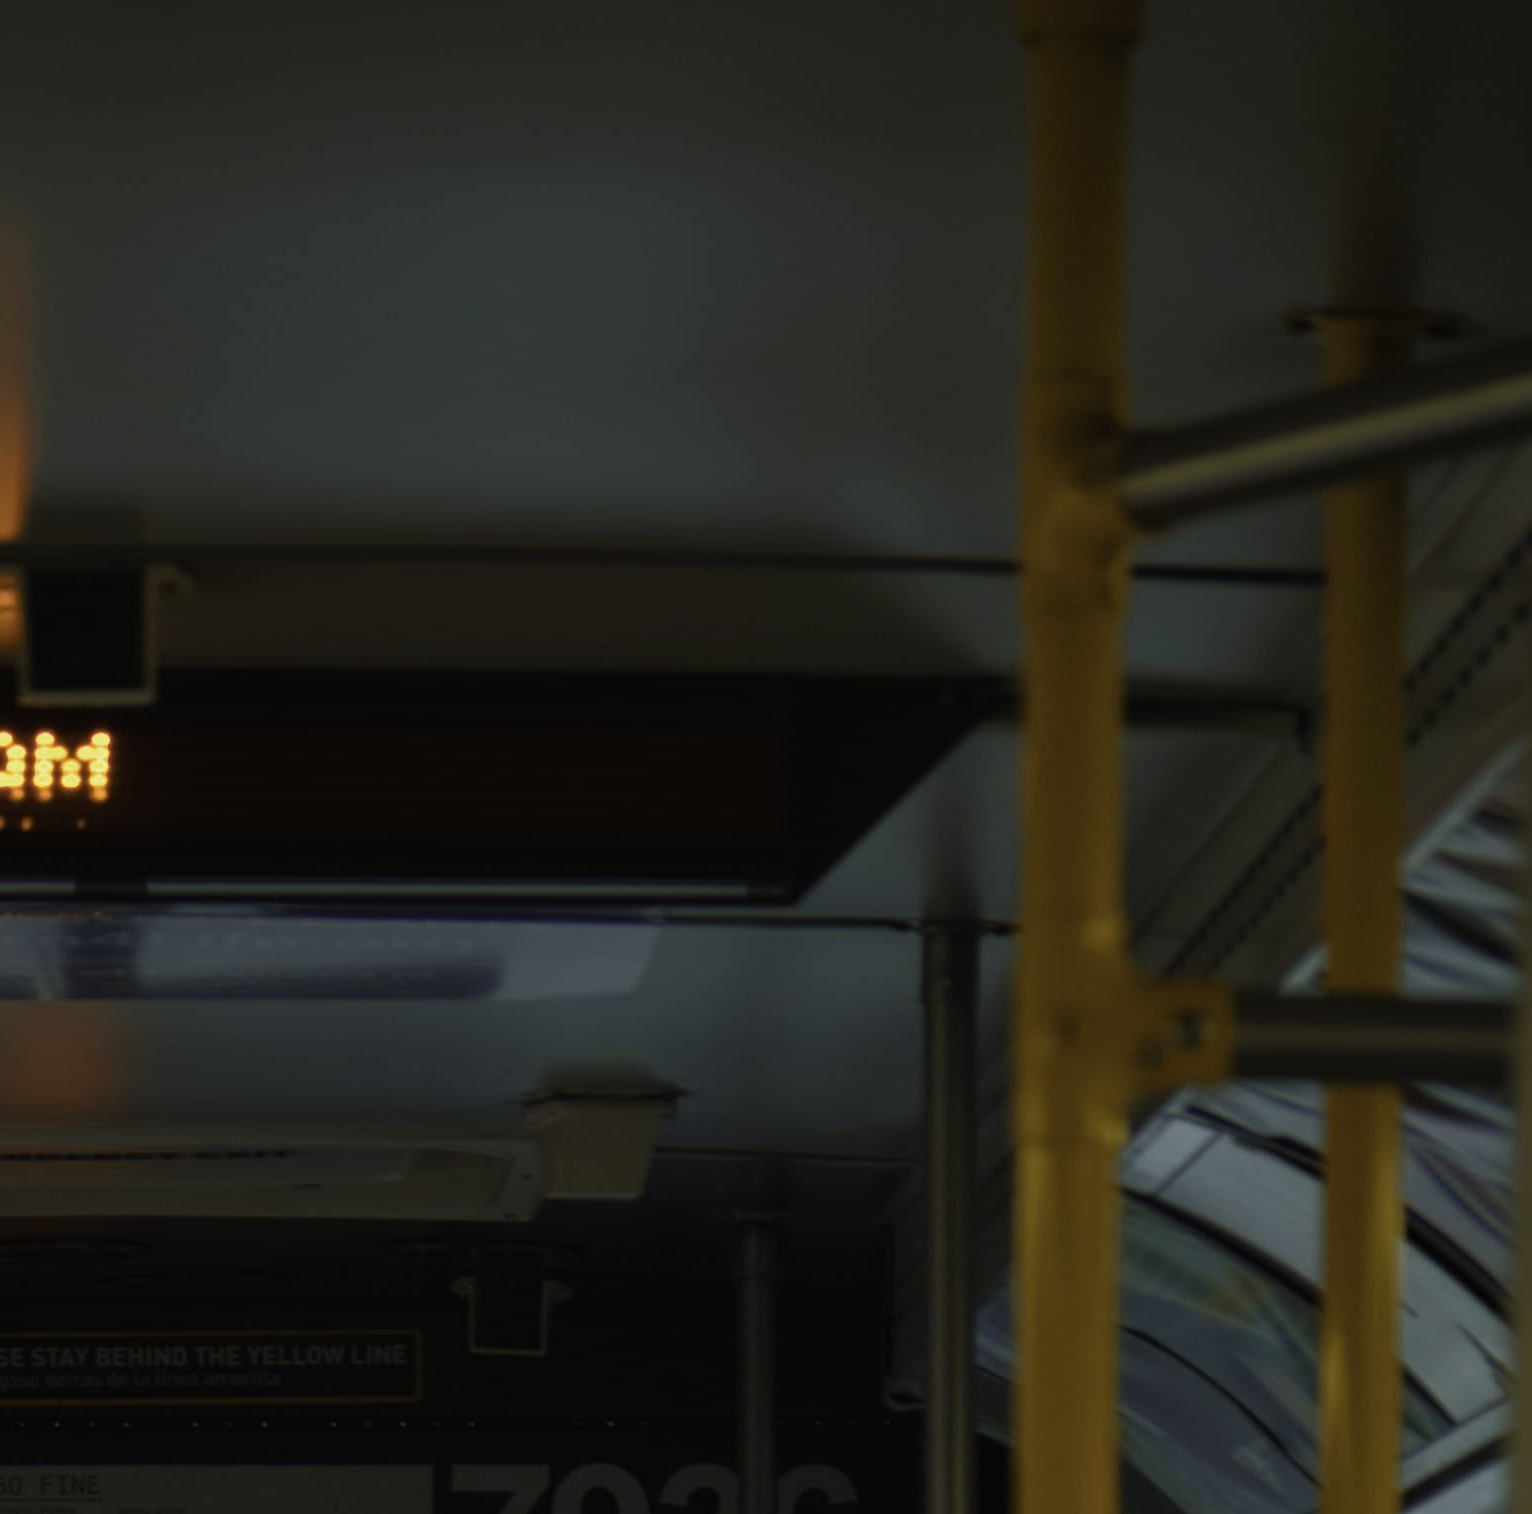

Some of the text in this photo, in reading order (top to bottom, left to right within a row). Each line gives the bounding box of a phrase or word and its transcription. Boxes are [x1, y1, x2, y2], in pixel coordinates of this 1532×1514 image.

[31, 1346, 89, 1368] STAY
[97, 1346, 188, 1368] BEHIND
[194, 1345, 241, 1367] THE
[247, 1344, 345, 1367] YELLOW
[351, 1344, 408, 1366] LINE
[39, 1474, 101, 1497] FINE
